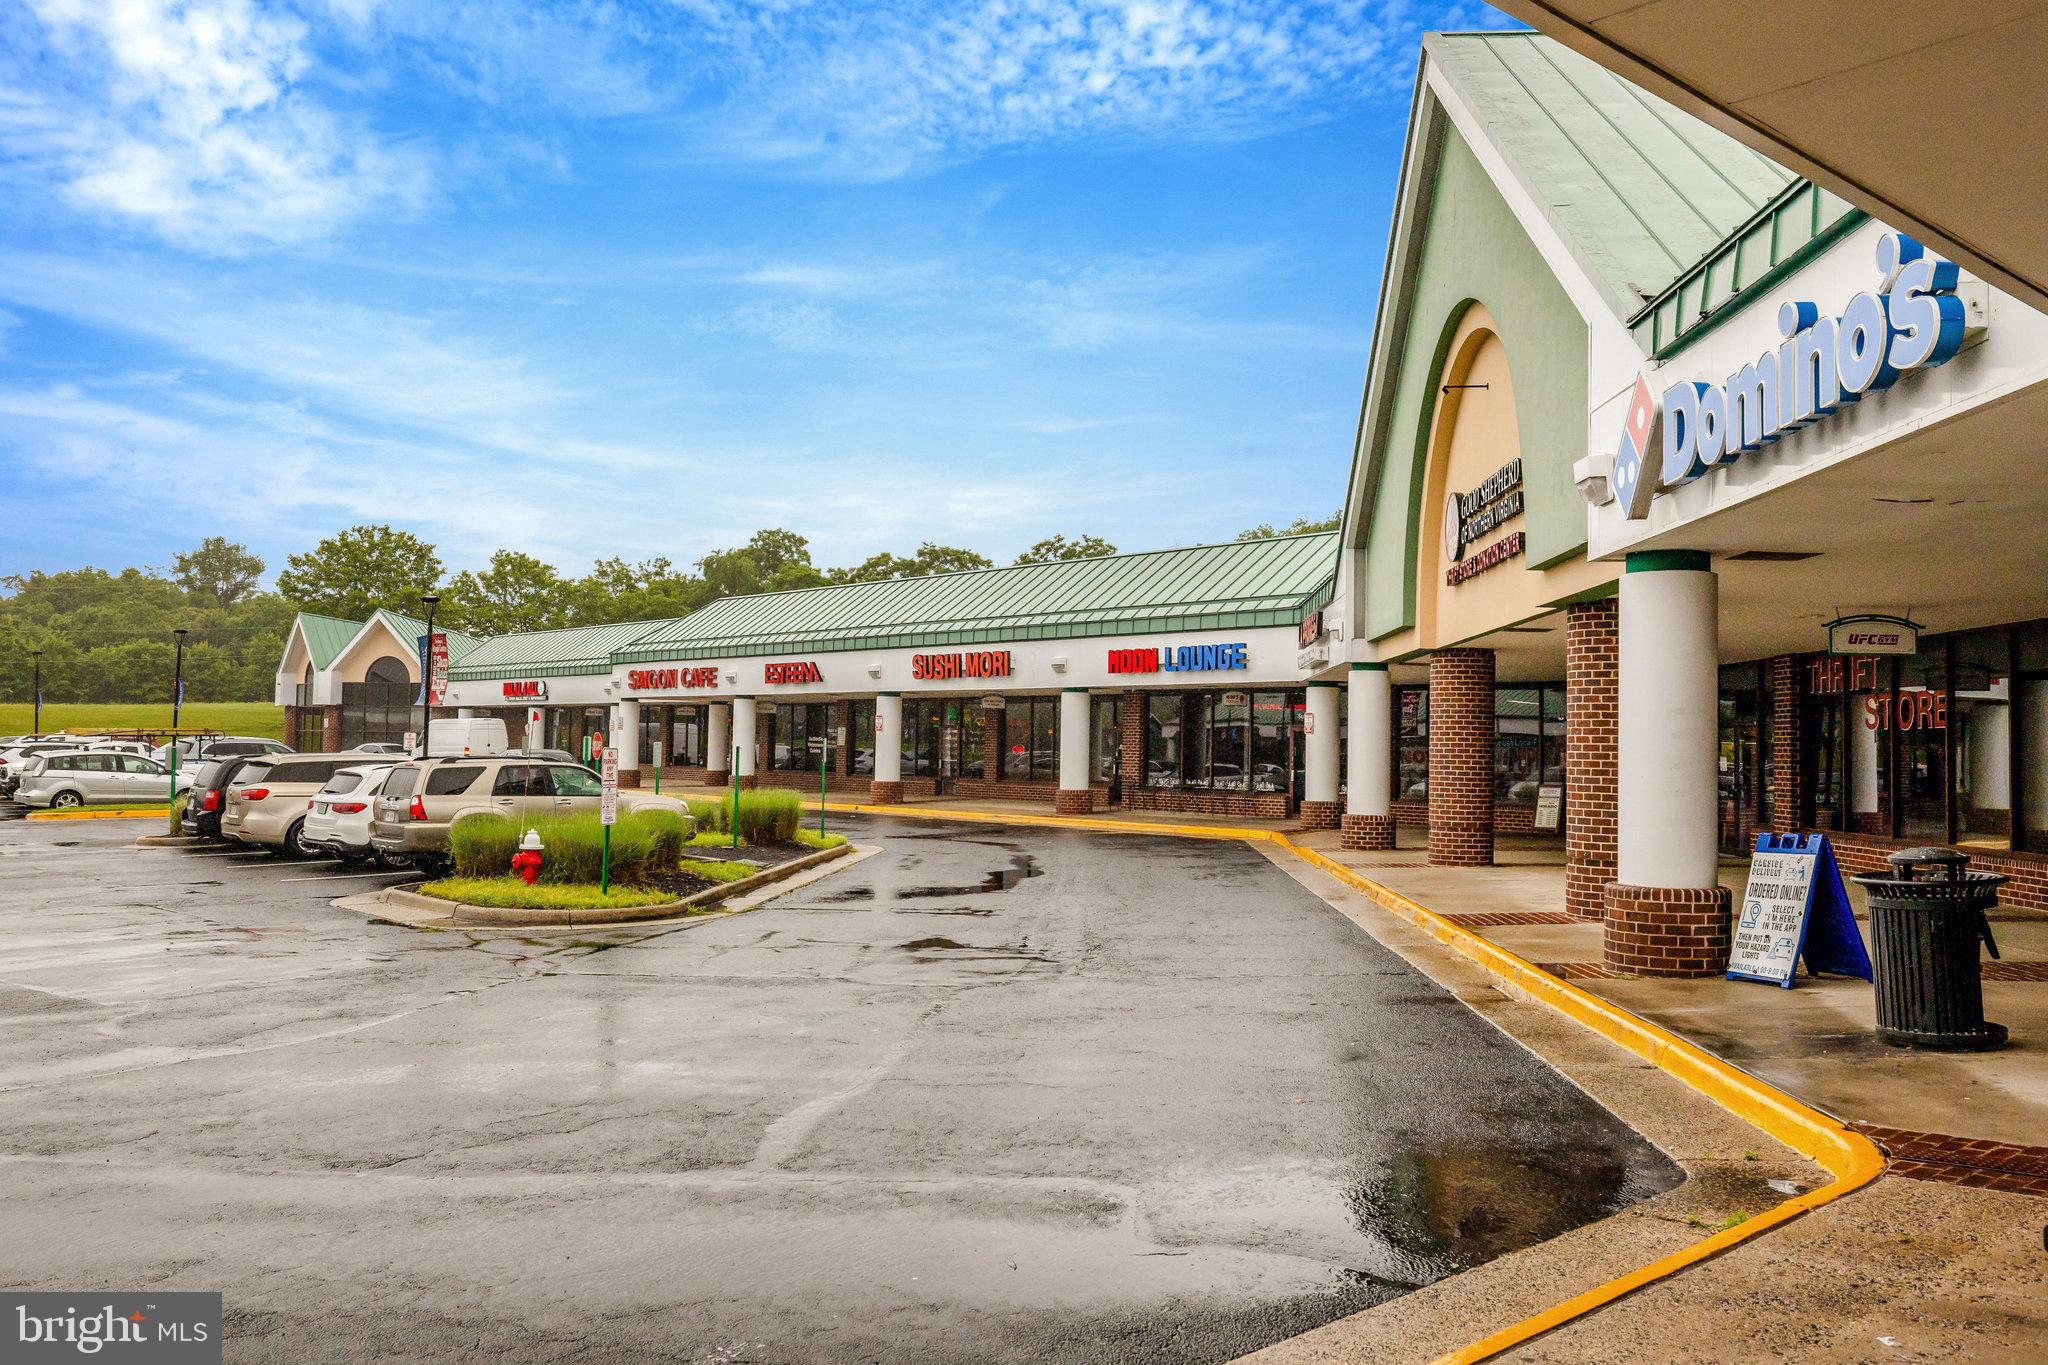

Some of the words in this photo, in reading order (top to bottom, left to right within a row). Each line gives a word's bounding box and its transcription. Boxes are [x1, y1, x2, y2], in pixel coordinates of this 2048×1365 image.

[1663, 233, 1960, 486] Domino's
[1461, 487, 1480, 519] GOOD
[1480, 458, 1521, 506] SHEPHERD
[1495, 491, 1522, 524] VIRGINIA
[1499, 531, 1520, 562] CENTER
[1848, 633, 1878, 645] UFC
[1877, 634, 1900, 646] GYM
[912, 653, 963, 680] SUSHI
[965, 650, 1011, 678] MORI
[1108, 648, 1159, 674] MOON
[1164, 643, 1247, 672] LOUNGE
[628, 669, 679, 690] SAIGON
[681, 667, 719, 689] CAFE
[765, 661, 824, 684] ESTEEM
[1864, 691, 1948, 732] STORE
[603, 758, 618, 766] PARKING
[1749, 883, 1780, 899] ORDERED
[1780, 884, 1808, 902] ONLINE?
[1772, 905, 1795, 914] SELECT
[1738, 932, 1753, 941] THEN
[1752, 934, 1764, 943] PUT
[1763, 935, 1771, 944] ON
[1761, 921, 1770, 930] IN
[1771, 922, 1784, 932] THE
[1783, 924, 1797, 933] APP
[1735, 940, 1749, 950] YOUR
[1749, 943, 1771, 953] HAZARD
[1741, 951, 1760, 961] LIGHTS
